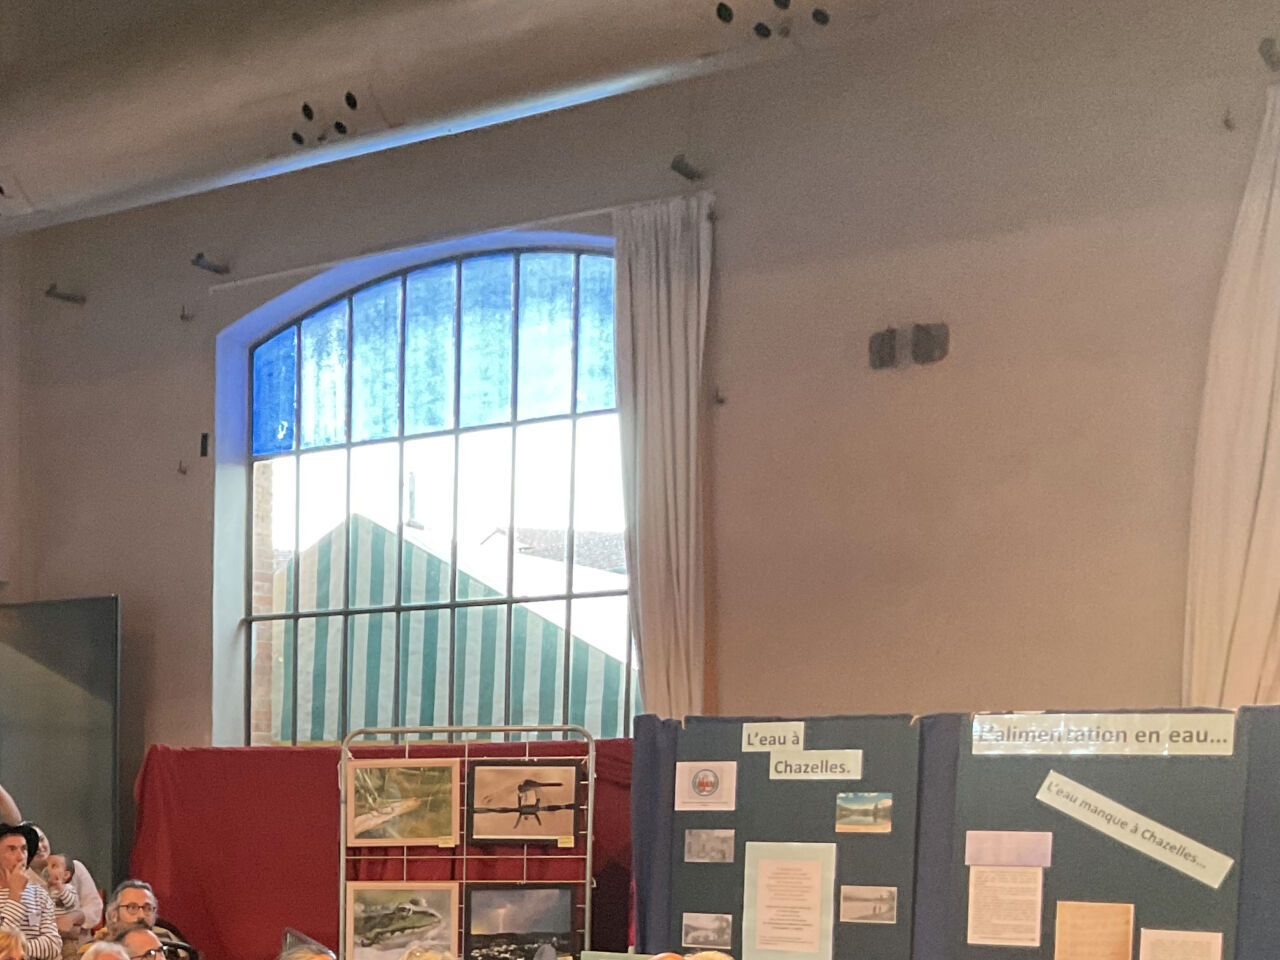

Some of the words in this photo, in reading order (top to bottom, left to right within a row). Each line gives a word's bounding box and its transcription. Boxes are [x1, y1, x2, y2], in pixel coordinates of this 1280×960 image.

[747, 732, 787, 747] L'eau
[791, 730, 800, 746] à
[979, 726, 1128, 744] L'alimentation
[1135, 728, 1161, 744] en
[1168, 728, 1228, 744] eau...
[774, 759, 851, 775] Chazelles.
[1046, 780, 1078, 804] L'eau
[1079, 799, 1129, 830] manque
[1129, 822, 1139, 835] à
[1140, 828, 1207, 870] Chazelles...
